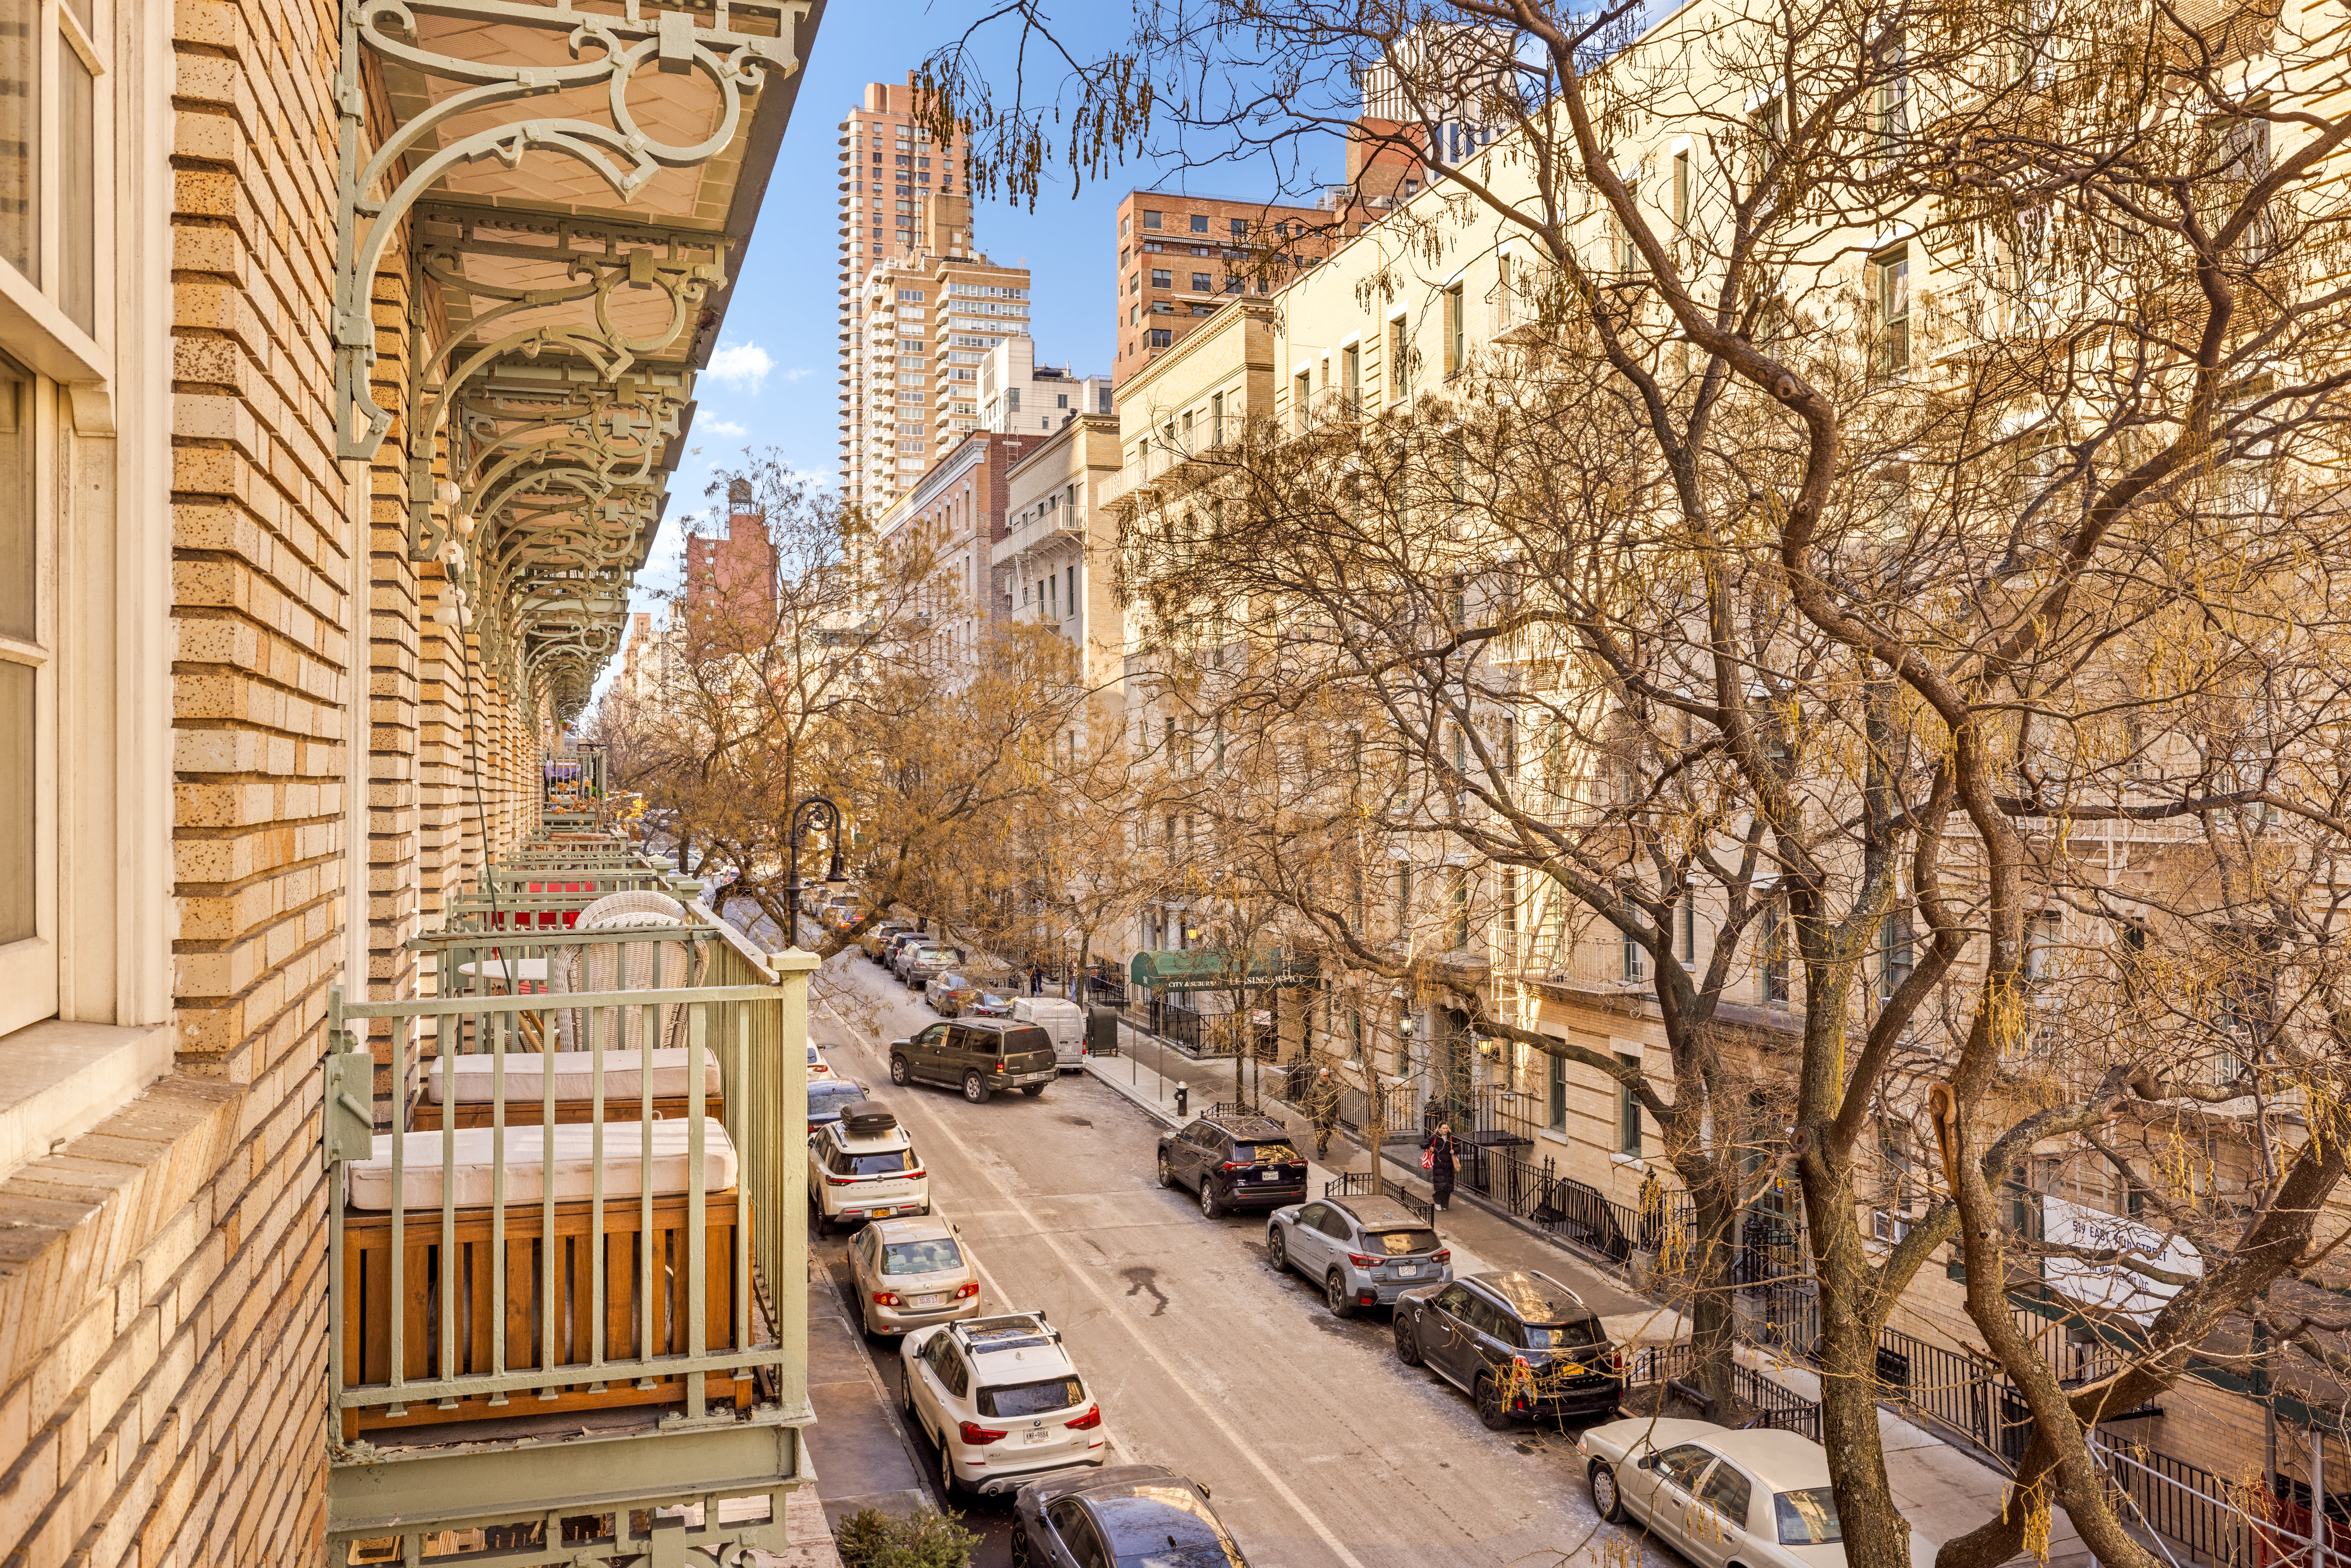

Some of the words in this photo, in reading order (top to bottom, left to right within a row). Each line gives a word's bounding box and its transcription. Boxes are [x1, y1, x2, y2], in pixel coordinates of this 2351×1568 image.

[2073, 1221, 2085, 1234] 519
[2100, 1266, 2136, 1284] MANGEMENT
[2092, 1291, 2106, 1300] informati
